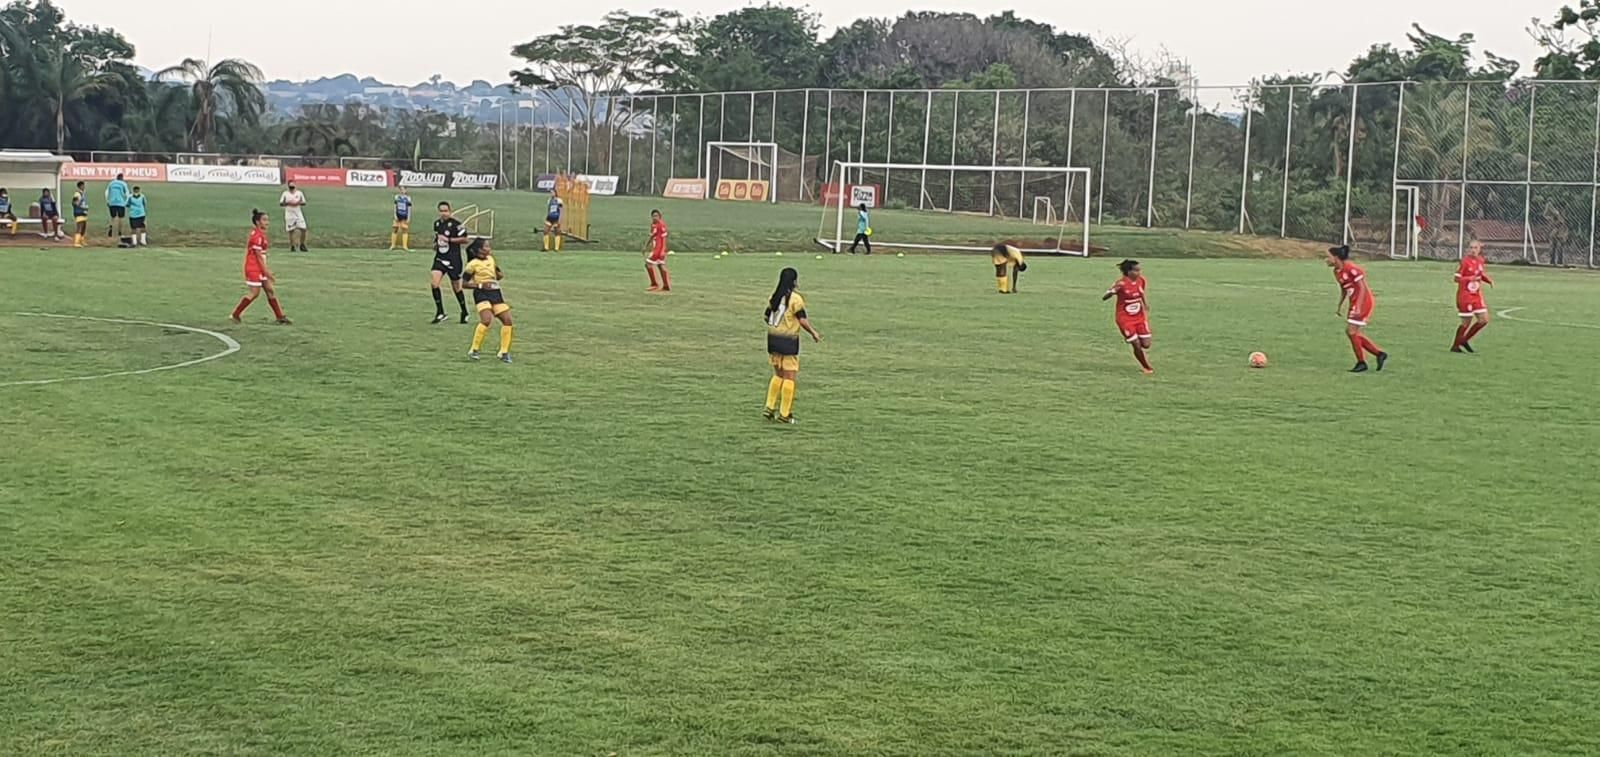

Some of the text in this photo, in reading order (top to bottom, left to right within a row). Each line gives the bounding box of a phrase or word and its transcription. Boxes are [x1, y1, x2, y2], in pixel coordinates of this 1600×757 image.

[73, 166, 96, 177] NEW
[125, 167, 158, 177] PNEUS
[350, 171, 384, 183] Rizzo
